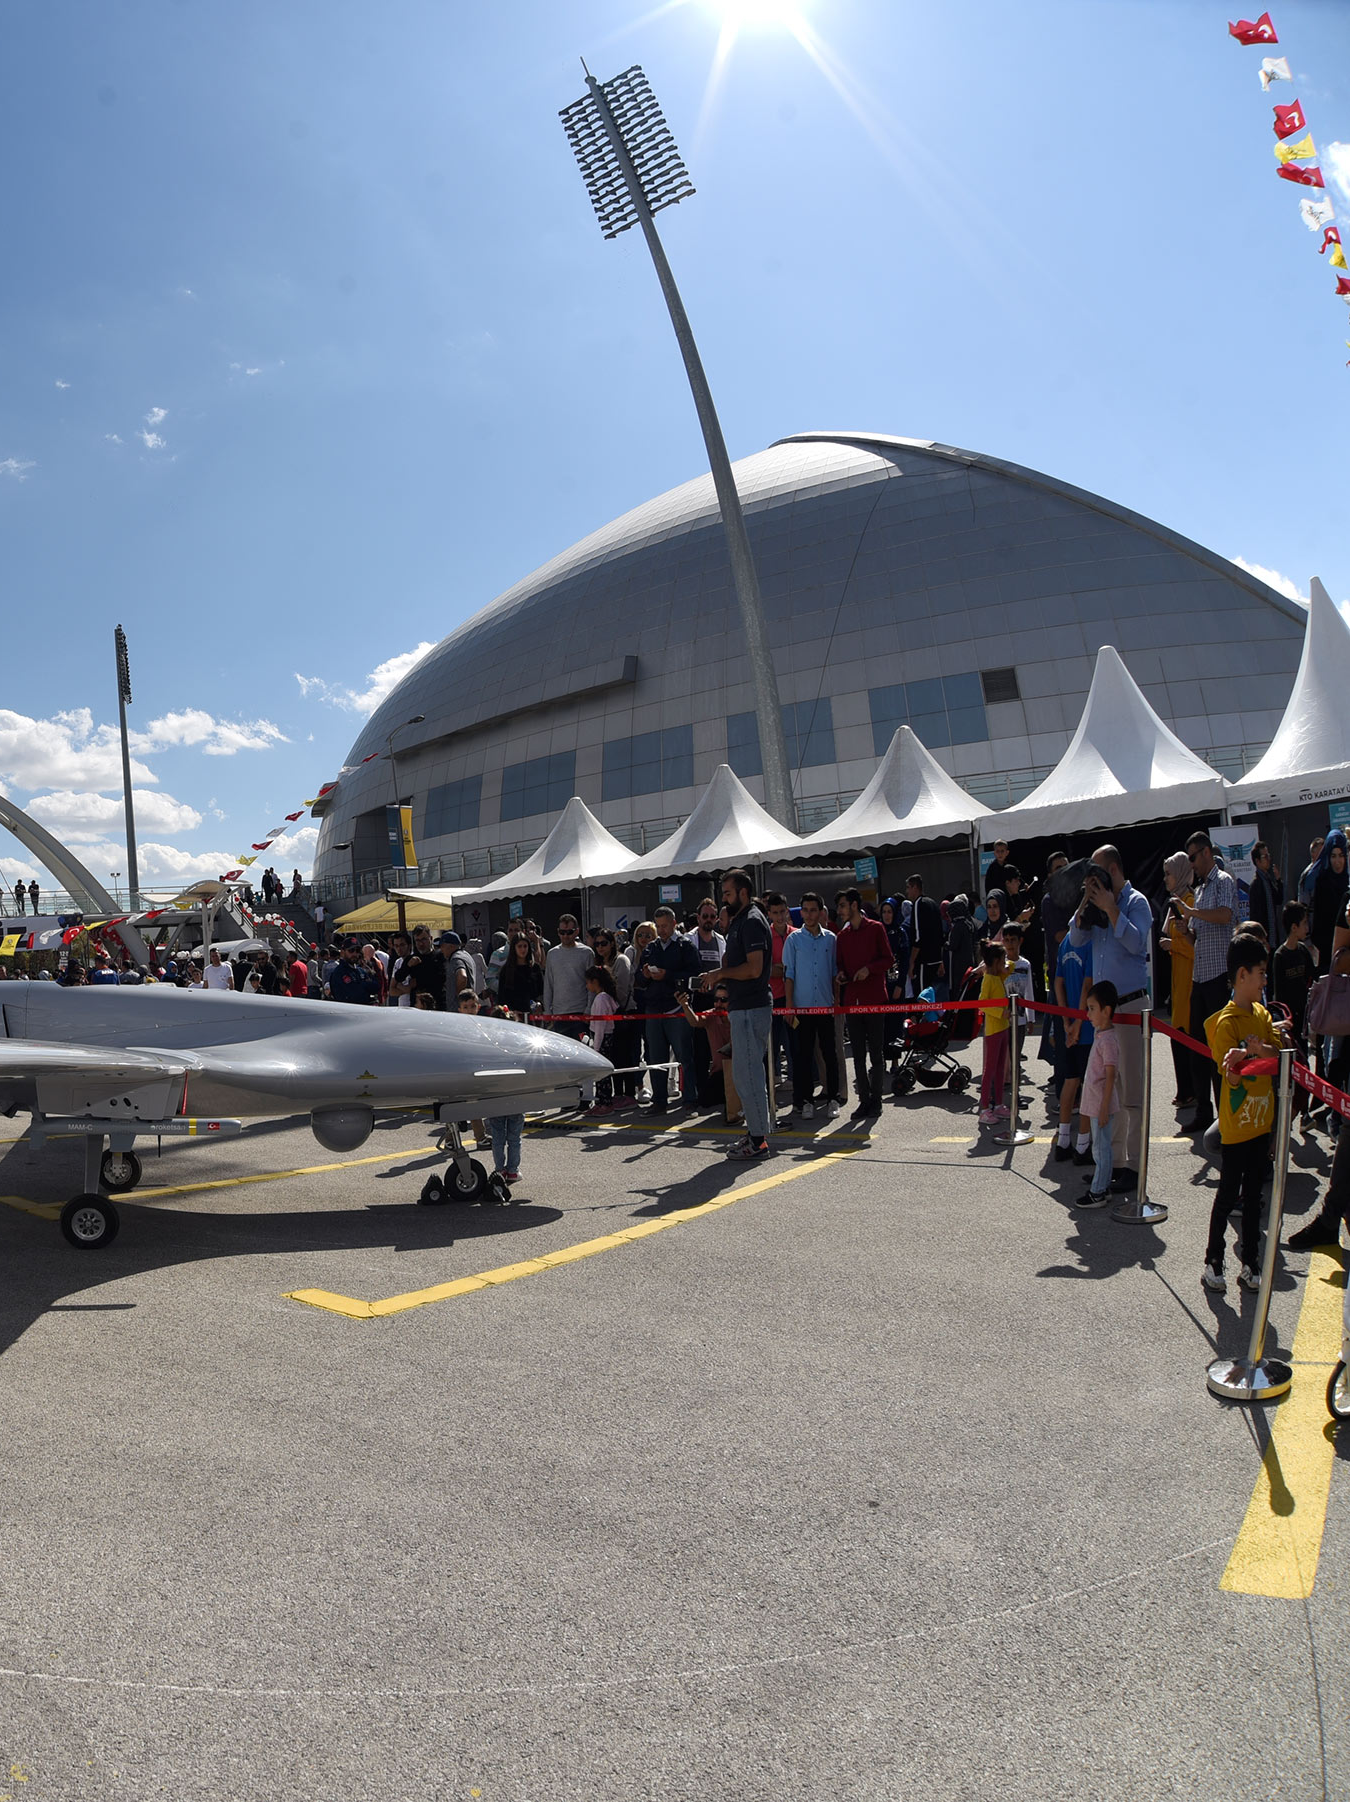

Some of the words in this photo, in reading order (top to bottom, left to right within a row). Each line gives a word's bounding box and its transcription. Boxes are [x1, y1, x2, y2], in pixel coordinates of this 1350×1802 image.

[1299, 793, 1313, 802] KTO
[1314, 786, 1346, 799] KARATAY
[911, 1003, 942, 1011] MERKEZİ
